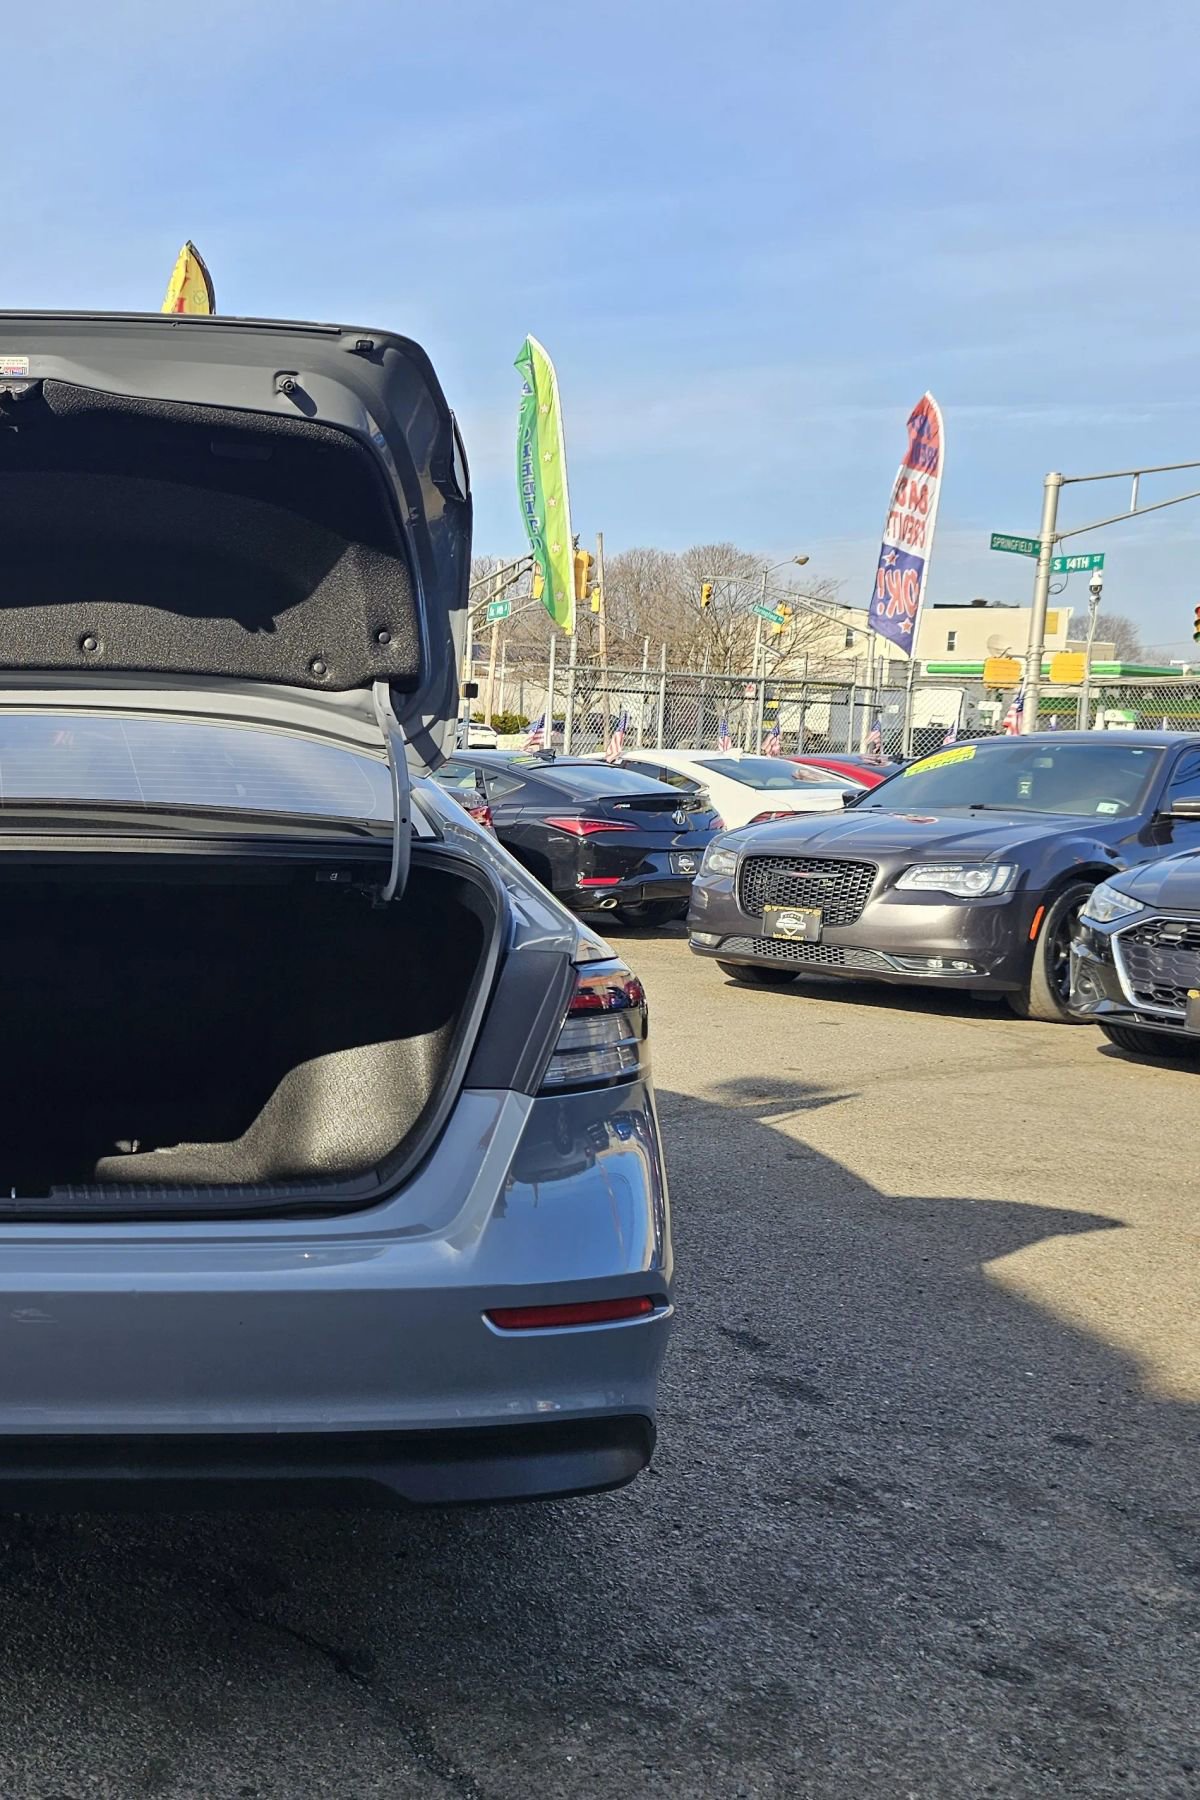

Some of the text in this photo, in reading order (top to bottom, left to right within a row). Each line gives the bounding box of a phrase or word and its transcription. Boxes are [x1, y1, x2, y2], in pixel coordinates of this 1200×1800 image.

[992, 536, 1033, 553] SPRINGFIELD
[1053, 560, 1062, 571] S
[1065, 556, 1090, 570] 14TH
